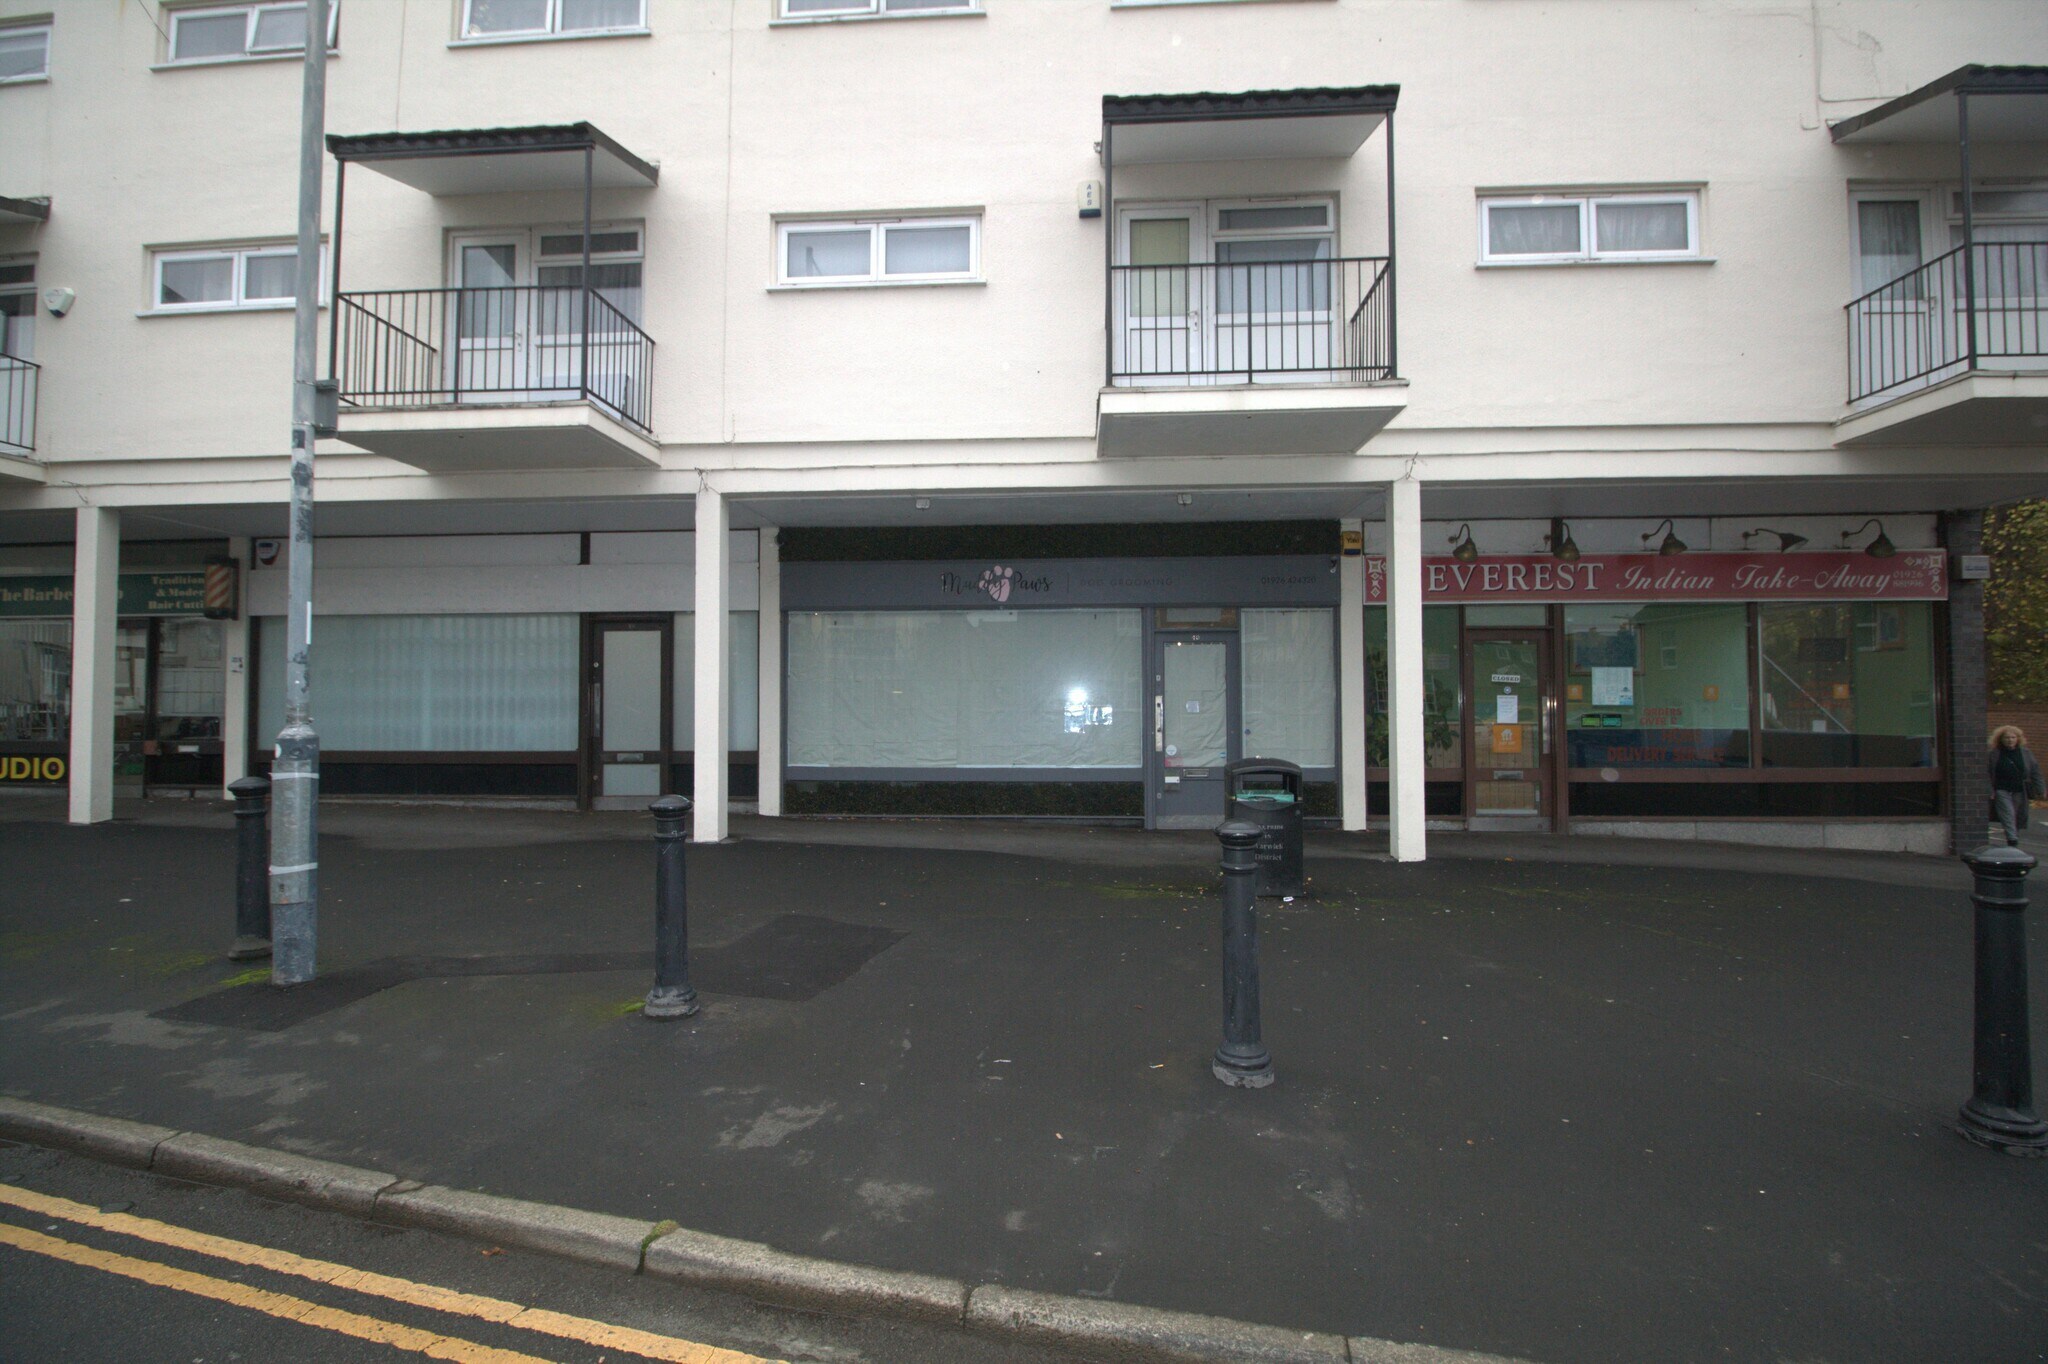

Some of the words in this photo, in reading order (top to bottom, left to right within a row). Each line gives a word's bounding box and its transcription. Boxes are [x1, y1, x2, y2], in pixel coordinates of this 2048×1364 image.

[1426, 563, 1604, 592] EVEREST
[1615, 564, 1715, 590] Indian
[1892, 570, 1925, 579] 01926
[151, 576, 205, 585] Tradition
[942, 569, 1006, 601] Muddy
[1012, 571, 1054, 593] Paws
[1109, 578, 1174, 586] GROOMING
[23, 587, 73, 602] Barbe
[168, 588, 205, 597] Moder
[148, 601, 174, 610] Hair
[175, 601, 204, 610] Cutti
[1607, 746, 1667, 763] DELIVERY
[1672, 746, 1727, 763] SERVICE
